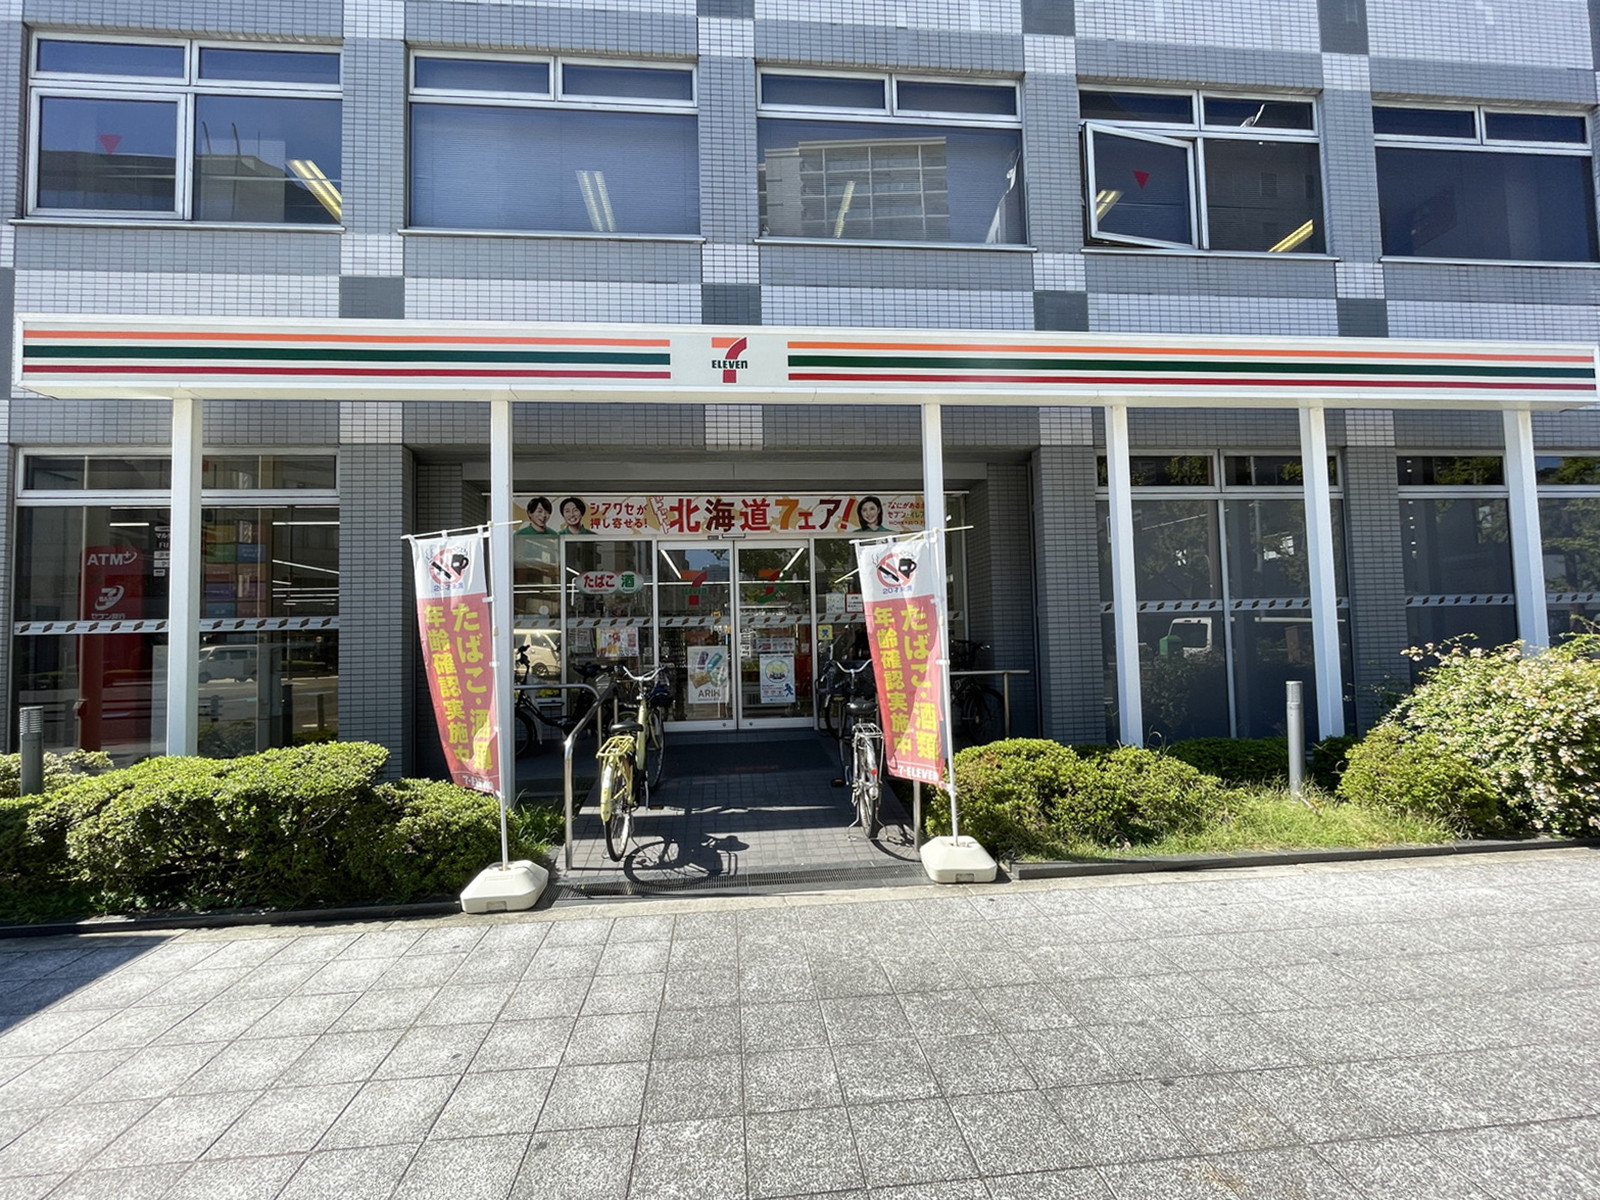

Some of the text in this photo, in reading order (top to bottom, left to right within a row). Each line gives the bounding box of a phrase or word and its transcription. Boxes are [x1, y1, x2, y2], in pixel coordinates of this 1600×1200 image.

[590, 502, 647, 515] シアワセが
[590, 518, 648, 529] 押し寄せる!
[584, 574, 635, 588] たばこ 酒
[425, 605, 471, 763] 年齢確認実施中
[873, 607, 912, 756] 年齢確認実施中
